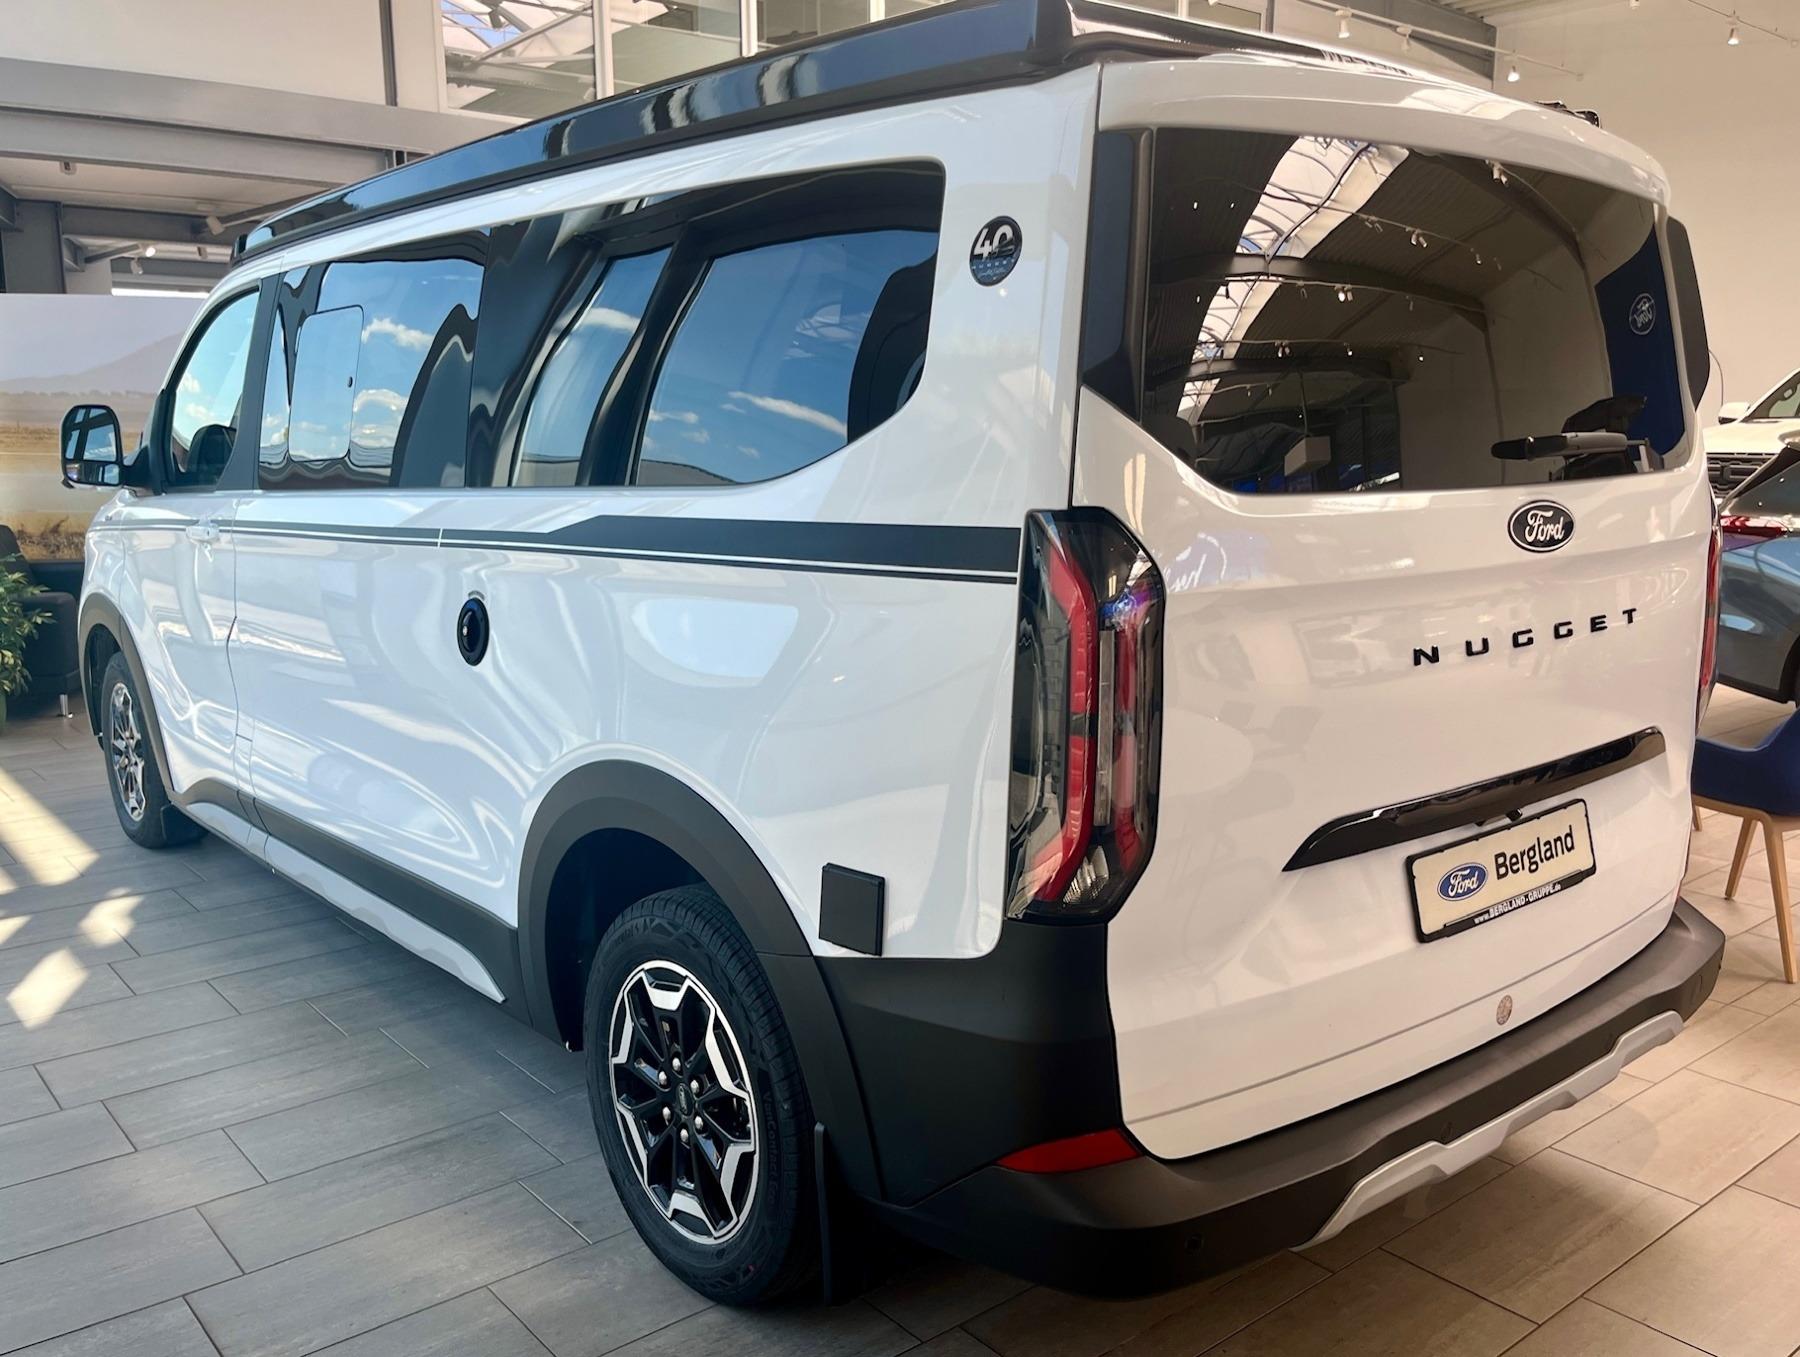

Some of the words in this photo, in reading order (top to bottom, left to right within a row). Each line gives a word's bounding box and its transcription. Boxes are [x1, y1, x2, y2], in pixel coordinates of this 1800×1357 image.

[973, 224, 1014, 259] 40
[1524, 509, 1565, 543] Ford
[1412, 607, 1637, 666] NUGGET
[1448, 869, 1480, 897] Ford
[1494, 825, 1576, 881] Bergland
